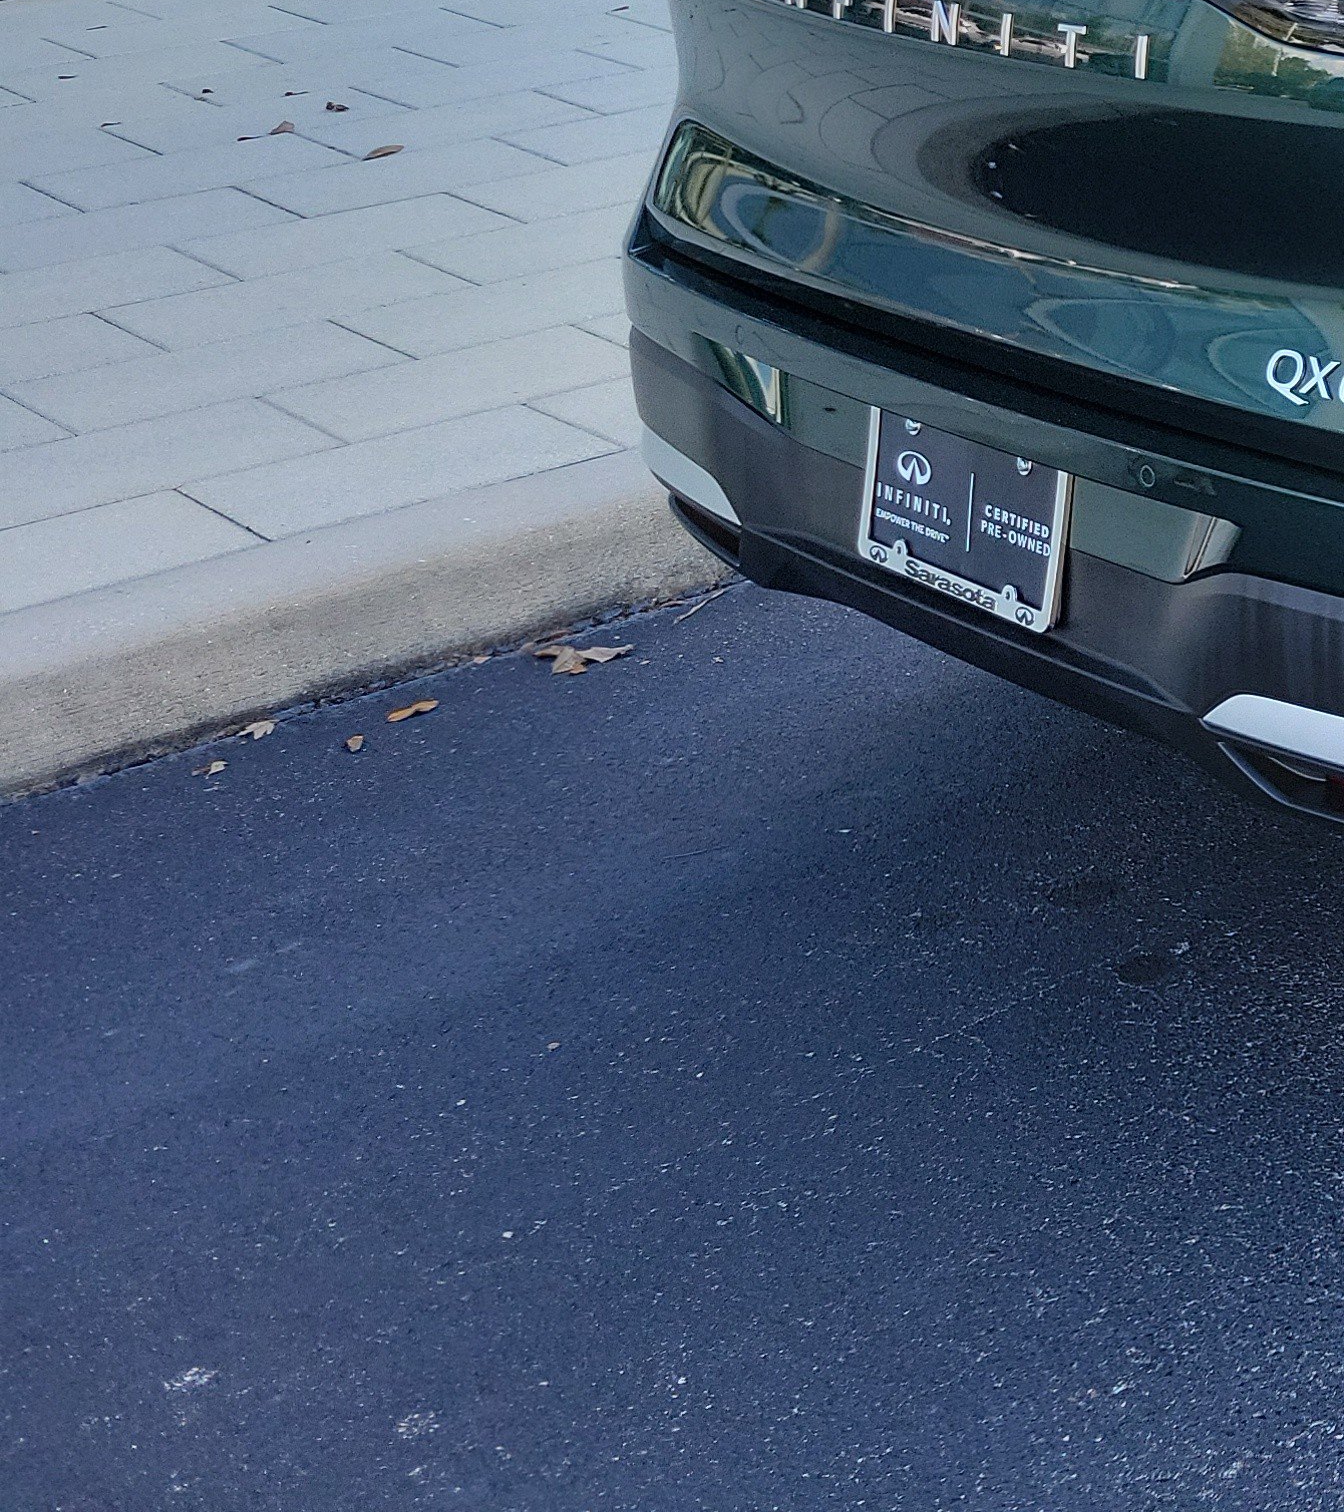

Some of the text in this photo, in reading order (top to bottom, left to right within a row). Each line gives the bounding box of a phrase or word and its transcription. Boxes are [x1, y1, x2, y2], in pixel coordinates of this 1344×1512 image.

[875, 507, 911, 529] EMPOWER
[911, 519, 925, 535] THE
[980, 519, 1052, 557] PRE-OWNED
[984, 504, 1050, 539] CERTIFIED
[904, 559, 997, 611] Sarasota
